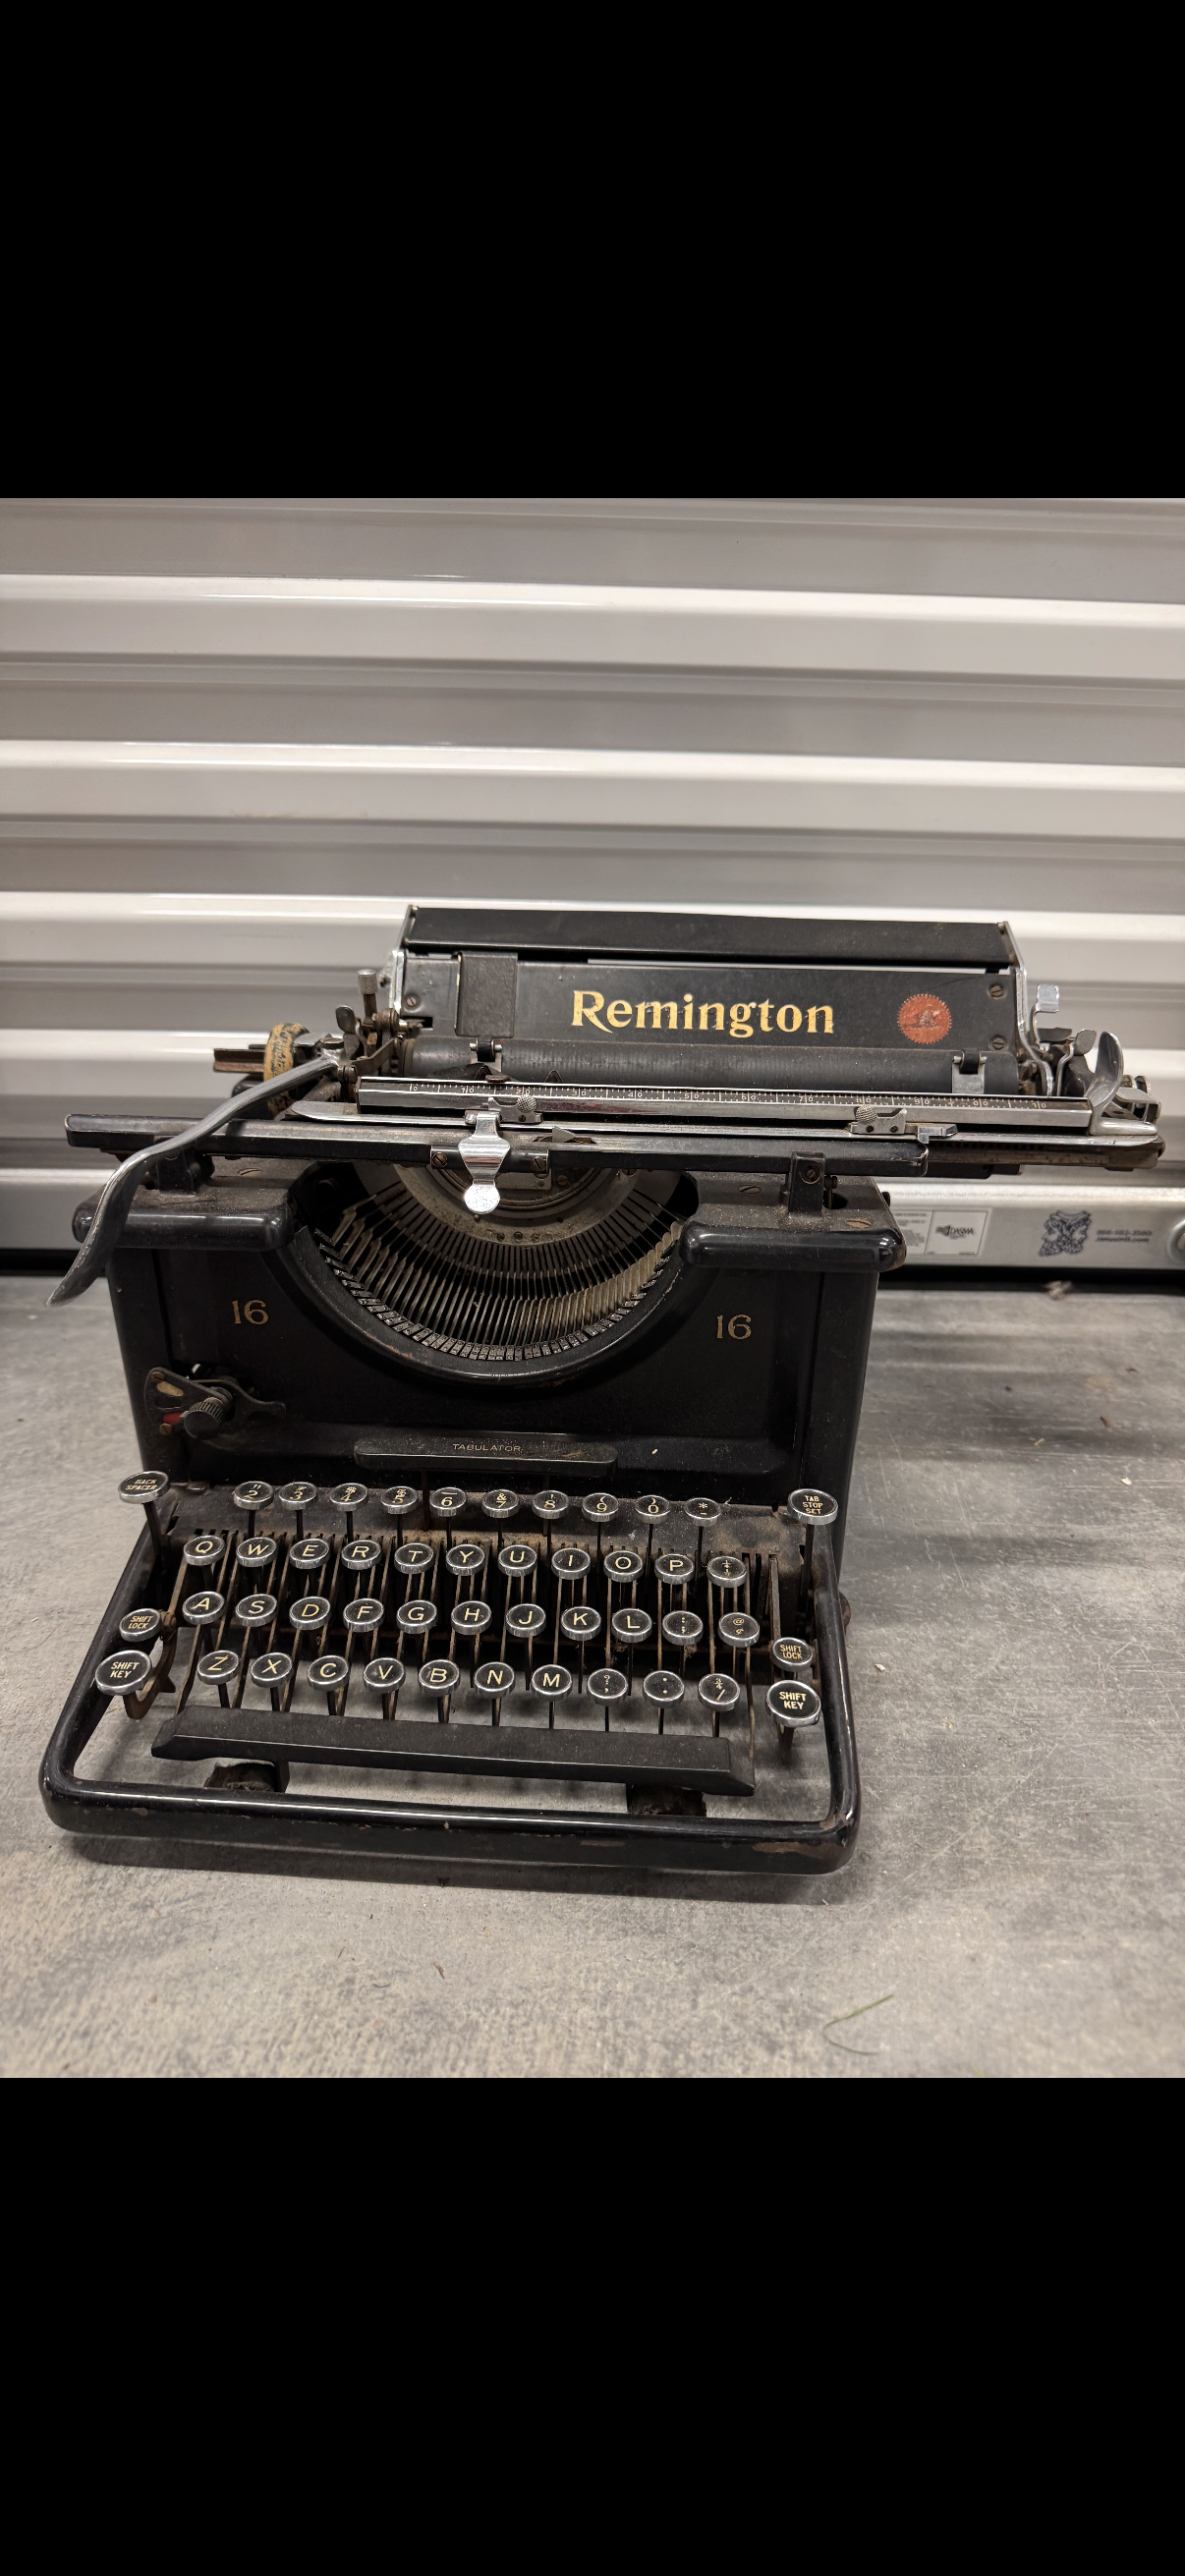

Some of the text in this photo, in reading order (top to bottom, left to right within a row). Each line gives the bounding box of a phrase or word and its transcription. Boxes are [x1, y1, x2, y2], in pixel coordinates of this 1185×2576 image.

[571, 989, 833, 1038] Remington
[232, 1300, 269, 1325] 16
[716, 1314, 752, 1340] 16
[452, 1443, 522, 1452] TABULATOR
[244, 1489, 258, 1500] 2
[289, 1490, 304, 1501] 3
[339, 1492, 352, 1502] 4
[391, 1494, 404, 1505] 5
[496, 1492, 507, 1501] &
[440, 1496, 453, 1507] 6
[495, 1500, 507, 1509] 7
[543, 1499, 556, 1509] 8
[595, 1502, 607, 1513] 9
[196, 1540, 214, 1554] Q
[248, 1543, 269, 1556] W
[302, 1544, 319, 1557] E
[351, 1545, 369, 1557] R
[408, 1549, 423, 1563] T
[459, 1550, 474, 1563] Y
[510, 1550, 525, 1563] U
[568, 1554, 574, 1567] I
[615, 1556, 632, 1570] O
[669, 1559, 684, 1571] P
[191, 1597, 210, 1610] A
[248, 1600, 265, 1614] S
[302, 1603, 319, 1617] D
[357, 1605, 373, 1619] F
[408, 1606, 424, 1621] G
[464, 1607, 480, 1621] H
[518, 1610, 533, 1625] J
[573, 1612, 588, 1625] K
[626, 1615, 641, 1629] L
[779, 1644, 802, 1652] SHIFT
[207, 1654, 229, 1671] Z
[782, 1652, 803, 1660] LOCK
[110, 1661, 141, 1670] SHIFT
[261, 1658, 282, 1674] X
[319, 1662, 337, 1678] C
[377, 1664, 394, 1680] V
[109, 1670, 132, 1679] KEY
[429, 1667, 447, 1683] B
[486, 1669, 504, 1685] N
[542, 1672, 560, 1688] M
[779, 1691, 807, 1702] SHIFT
[783, 1700, 804, 1710] KEY
